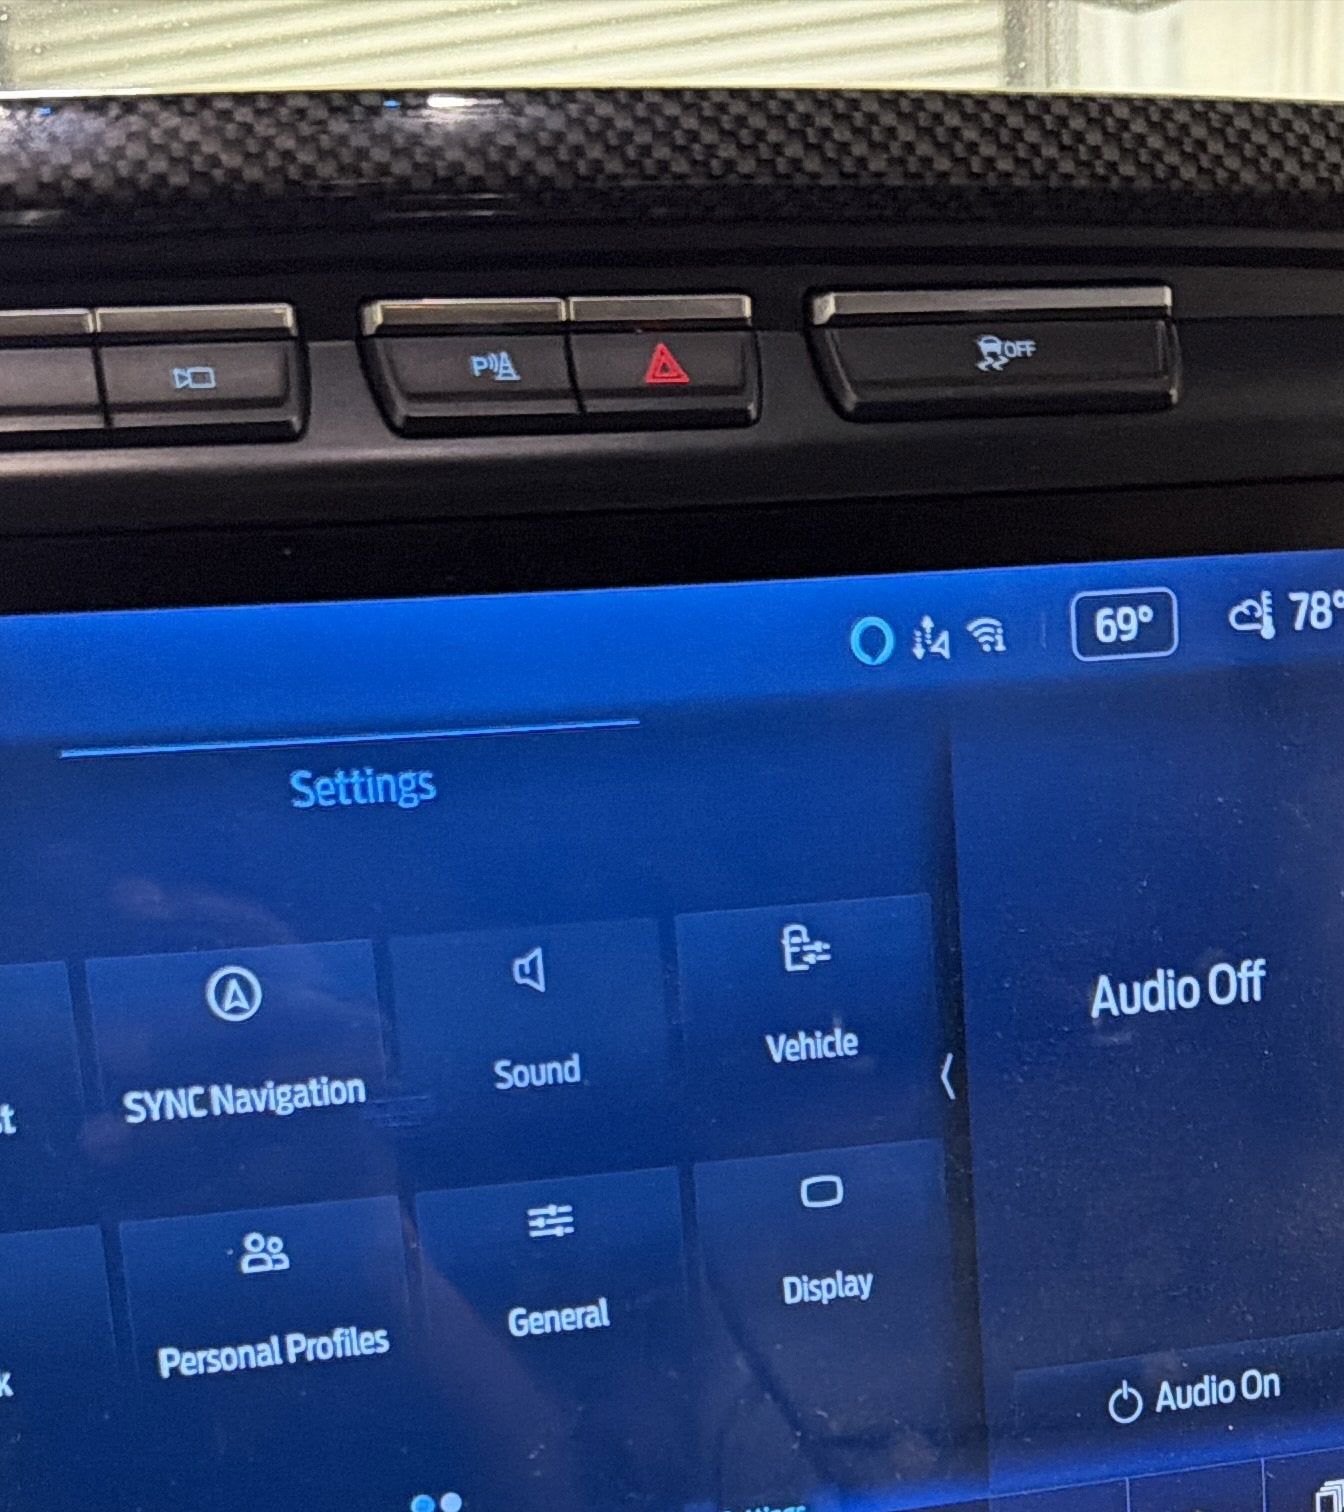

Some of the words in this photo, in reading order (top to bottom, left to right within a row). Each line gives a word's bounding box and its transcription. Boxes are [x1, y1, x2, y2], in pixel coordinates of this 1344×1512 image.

[1004, 339, 1038, 358] OFF
[1095, 604, 1154, 643] 69°
[289, 767, 437, 809] Settings
[1090, 968, 1201, 1019] Audio
[1208, 958, 1267, 1006] Off
[765, 1026, 859, 1064] Vehicle
[494, 1052, 581, 1090] Sound
[121, 1086, 212, 1126] SYNC
[207, 1072, 369, 1126] Navigation
[782, 1269, 874, 1305] Display
[508, 1296, 611, 1337] General
[158, 1334, 283, 1379] Personal
[284, 1326, 390, 1364] Profiles
[1155, 1374, 1236, 1413] Audio
[1240, 1368, 1281, 1400] On
